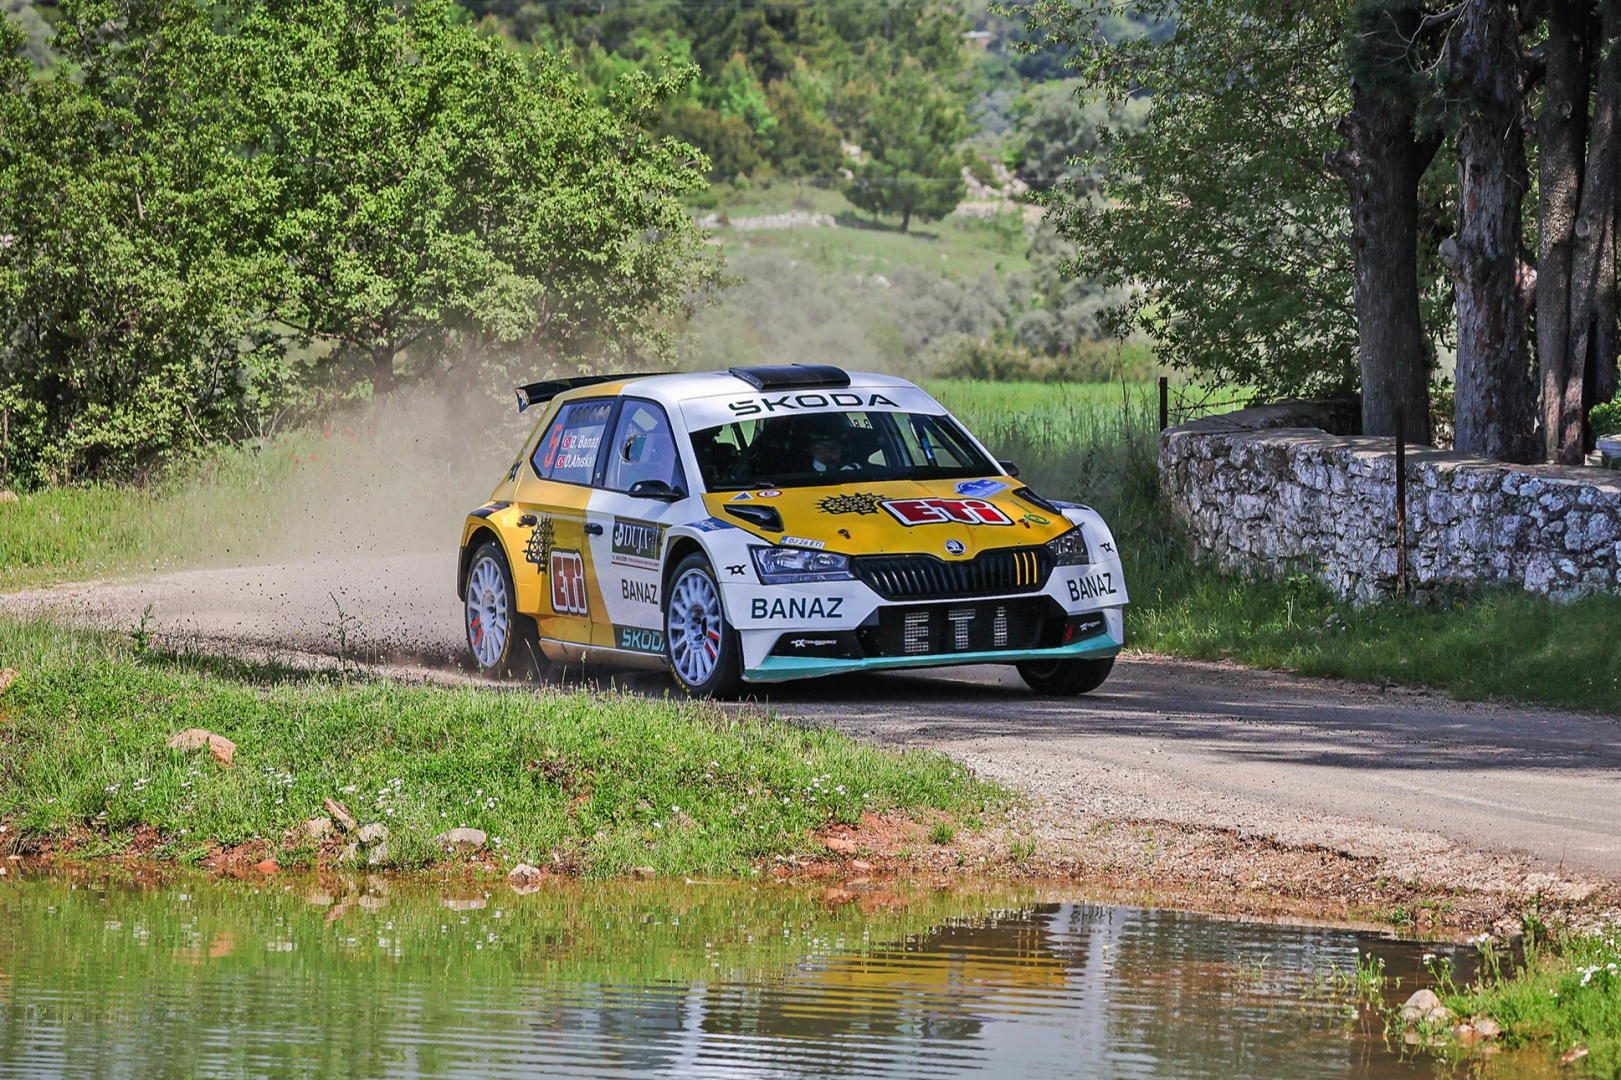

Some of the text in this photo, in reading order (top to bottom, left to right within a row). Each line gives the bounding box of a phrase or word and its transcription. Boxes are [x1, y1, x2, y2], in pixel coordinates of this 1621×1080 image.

[545, 424, 562, 467] 5
[621, 578, 658, 605] BANAZ
[1066, 572, 1117, 602] BANAZ
[751, 597, 843, 619] BANAZ
